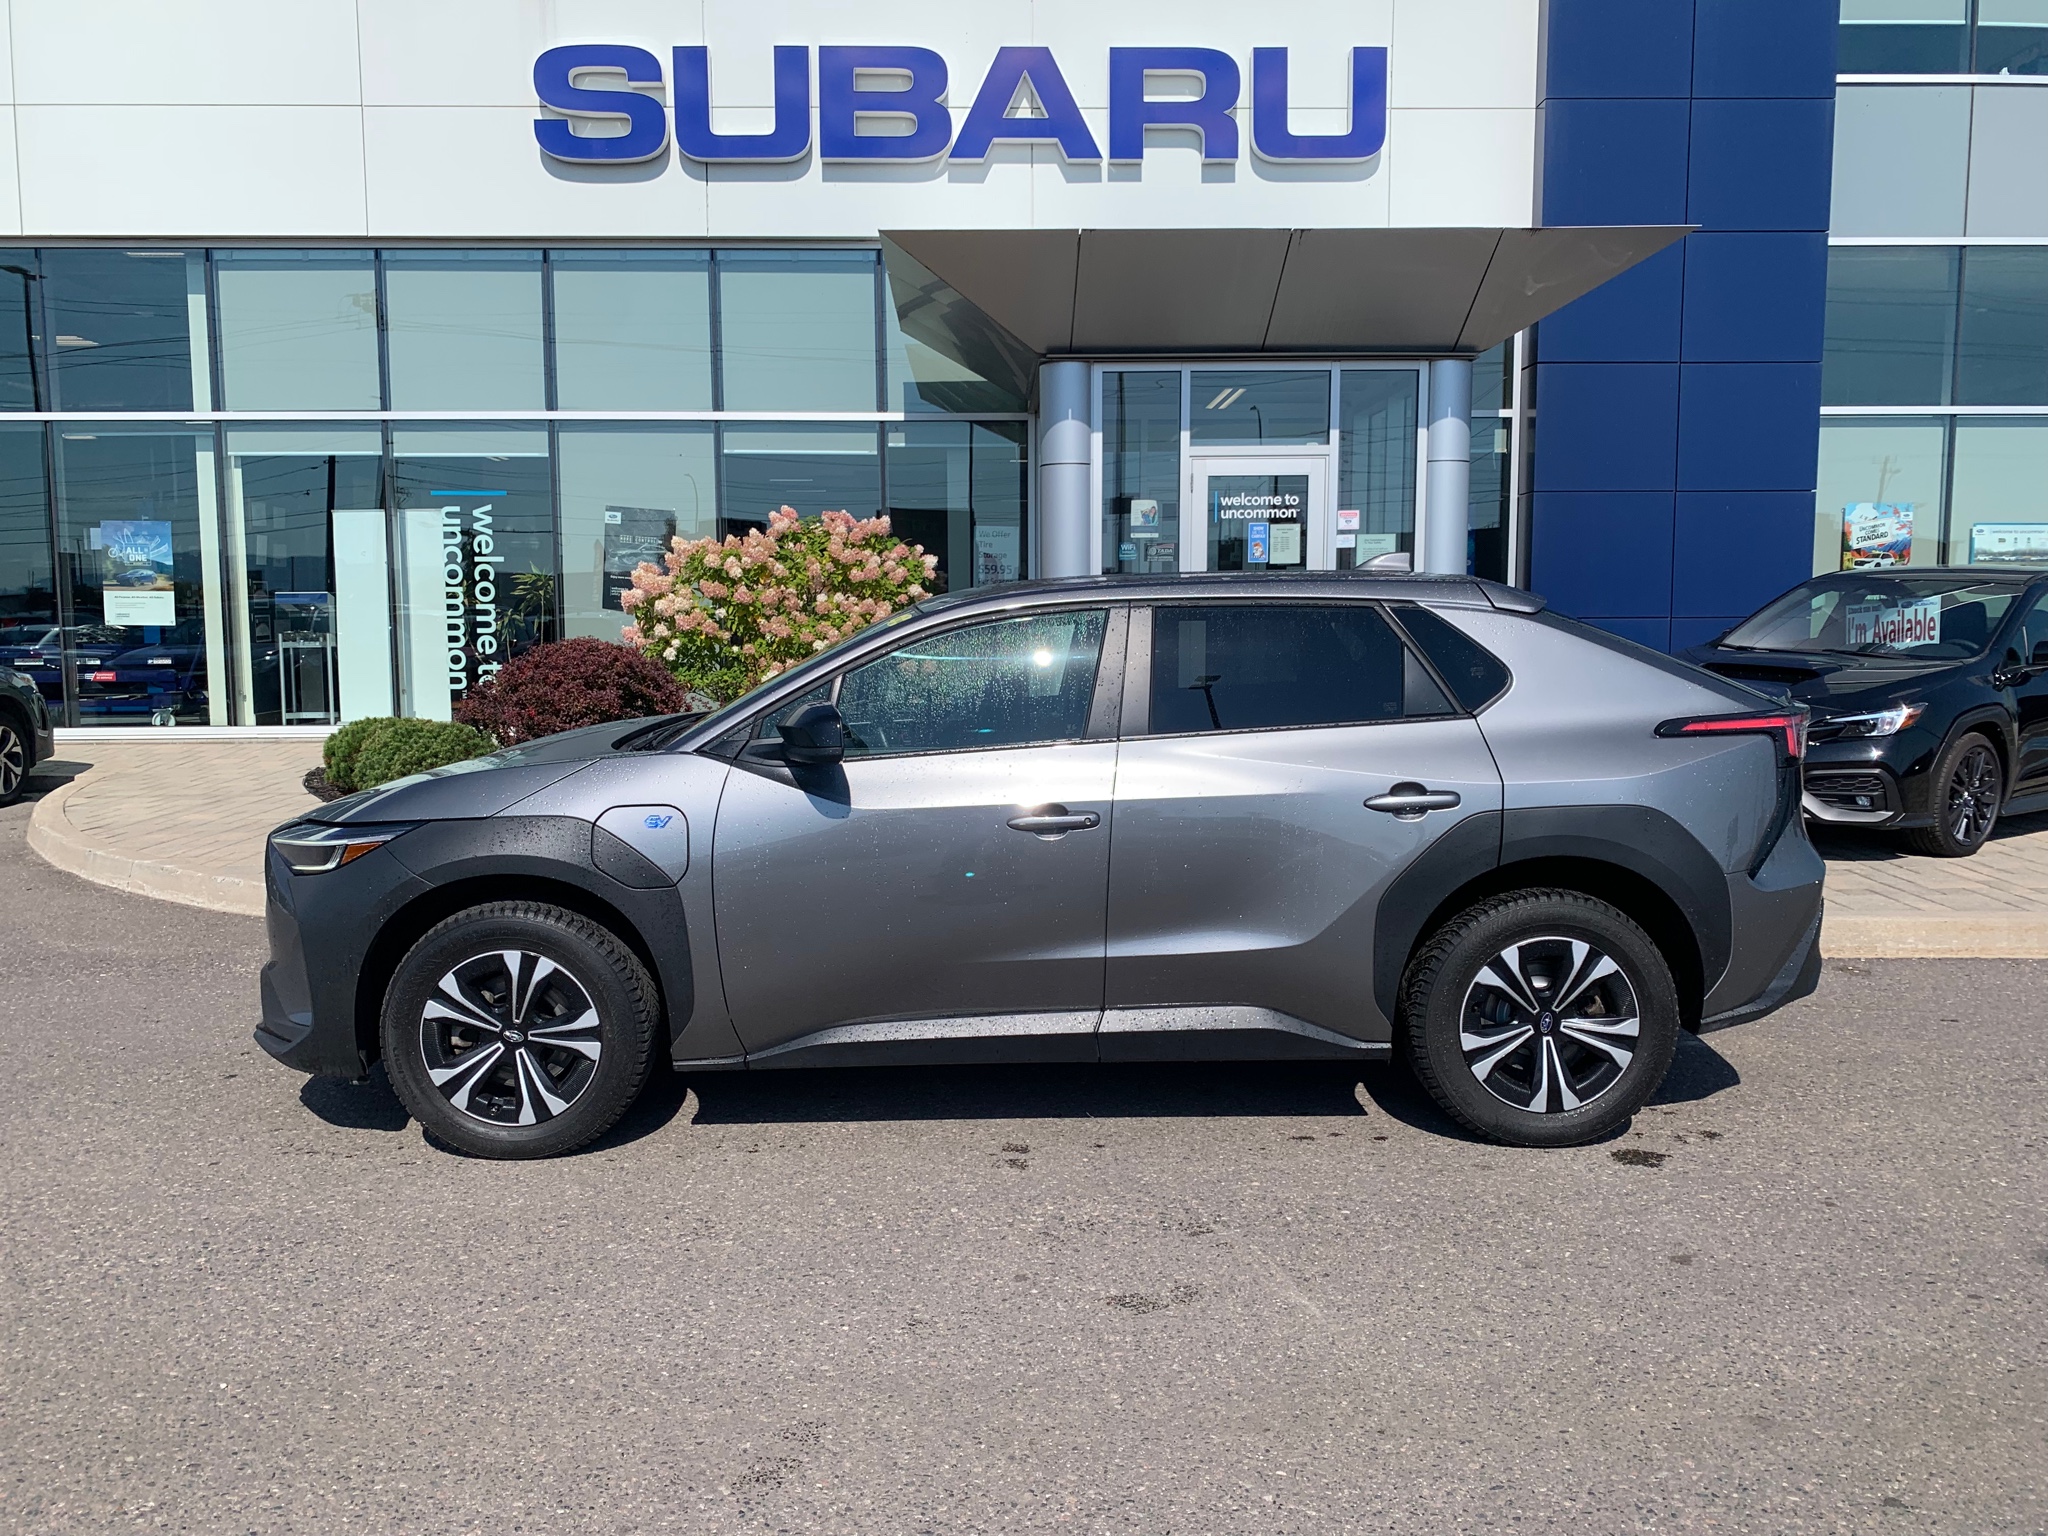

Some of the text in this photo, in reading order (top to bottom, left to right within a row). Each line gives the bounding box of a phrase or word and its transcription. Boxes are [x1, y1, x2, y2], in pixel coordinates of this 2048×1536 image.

[533, 44, 1388, 165] SUBARU
[1220, 492, 1299, 506] welcome to
[1858, 522, 1887, 532] UNCOMMON
[978, 530, 1011, 538] We Offer
[1856, 531, 1889, 545] STANDARD
[126, 546, 144, 554] ALL
[978, 541, 993, 549] Tire
[1120, 543, 1136, 551] WiFi
[128, 554, 148, 562] ONE
[978, 550, 1007, 560] Storage
[977, 564, 1013, 575] $59.95
[473, 504, 505, 655] welcome
[1847, 607, 1937, 645] I'm Available
